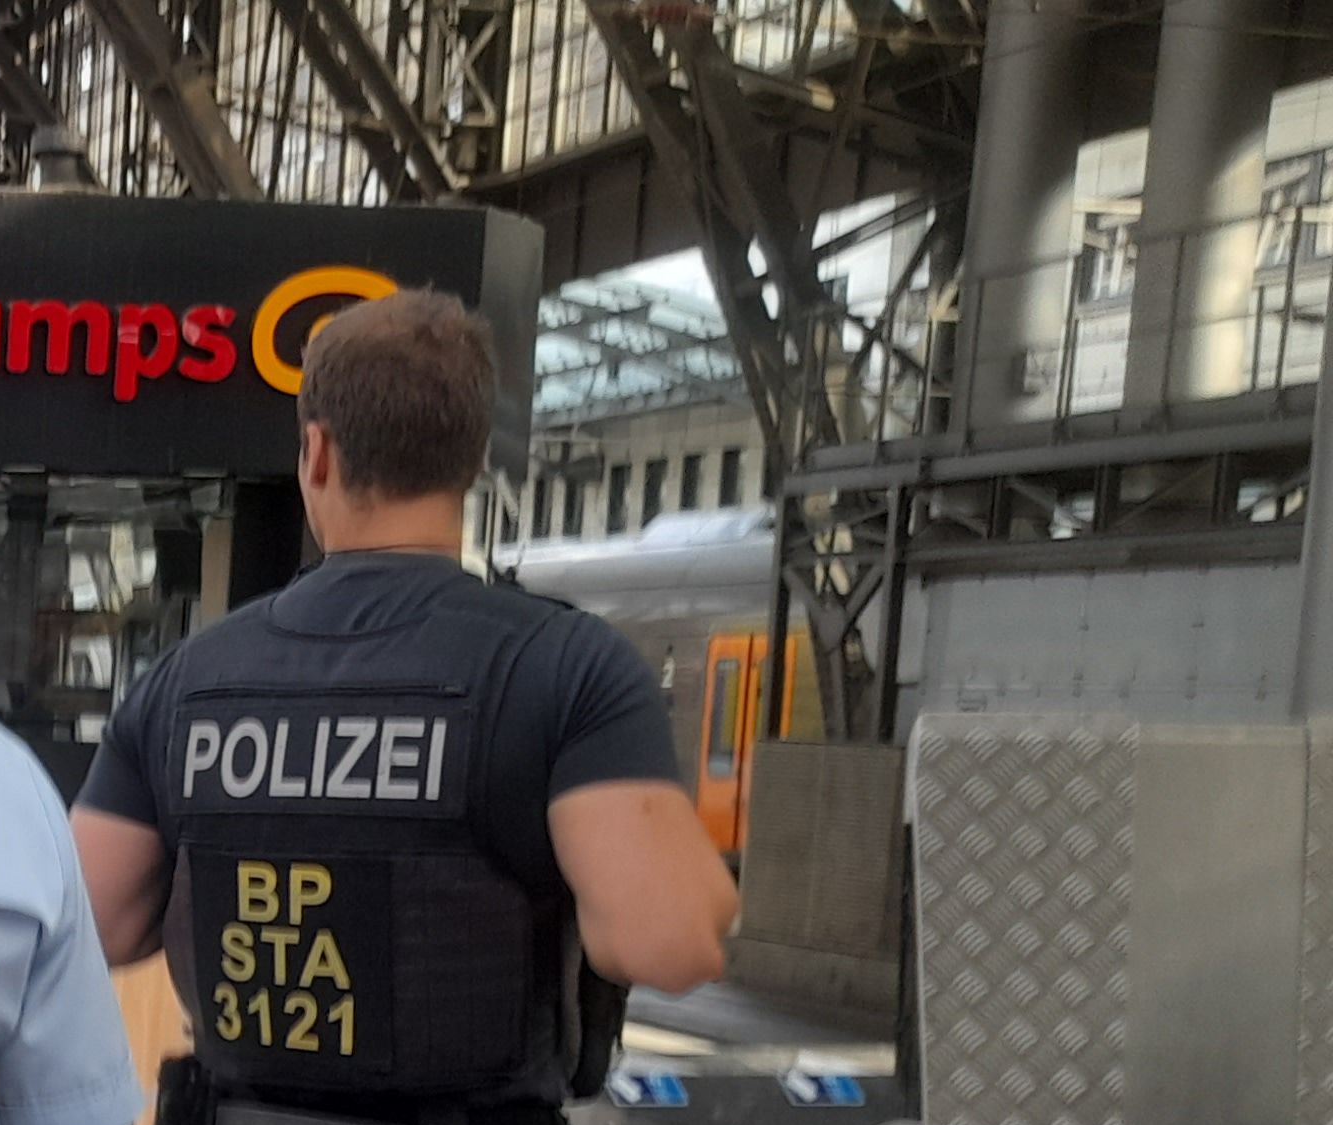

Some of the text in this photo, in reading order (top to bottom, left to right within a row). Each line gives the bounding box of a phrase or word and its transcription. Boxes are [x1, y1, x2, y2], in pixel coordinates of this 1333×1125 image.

[183, 715, 448, 801] POLIZEI
[237, 859, 333, 926] BP
[220, 921, 352, 991] STA
[213, 980, 356, 1056] 3121
